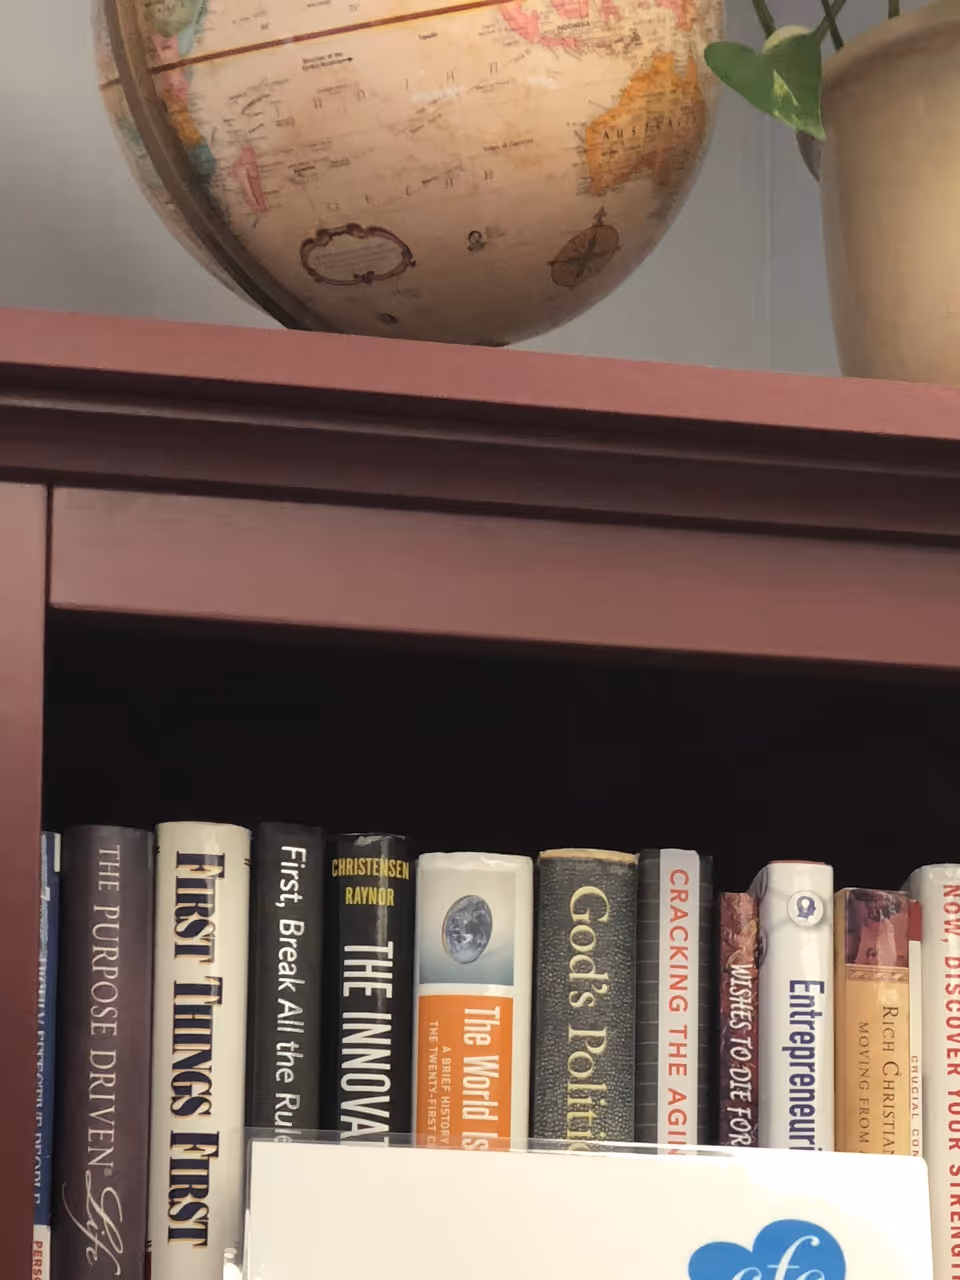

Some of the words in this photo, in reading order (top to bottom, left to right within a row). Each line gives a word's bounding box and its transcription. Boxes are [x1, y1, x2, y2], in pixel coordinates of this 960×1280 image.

[99, 845, 120, 891] THE
[276, 846, 306, 908] First,
[332, 858, 409, 880] CHRISTENSEN
[345, 887, 394, 906] RAYNOR
[174, 850, 226, 963] FIRST
[941, 884, 960, 943] NOW,
[90, 905, 120, 1036] PURPOSE
[277, 919, 305, 993] Break
[568, 886, 609, 1009] God's
[667, 869, 690, 1013] CRACKING
[170, 976, 223, 1119] THINGS
[277, 998, 305, 1034] All
[464, 1006, 500, 1046] The
[274, 1040, 304, 1083] the
[667, 1025, 688, 1076] THE
[462, 1054, 499, 1122] World
[911, 1055, 920, 1121] CRUCIAL
[167, 1130, 220, 1248] FIRST
[62, 1169, 124, 1276] Life
